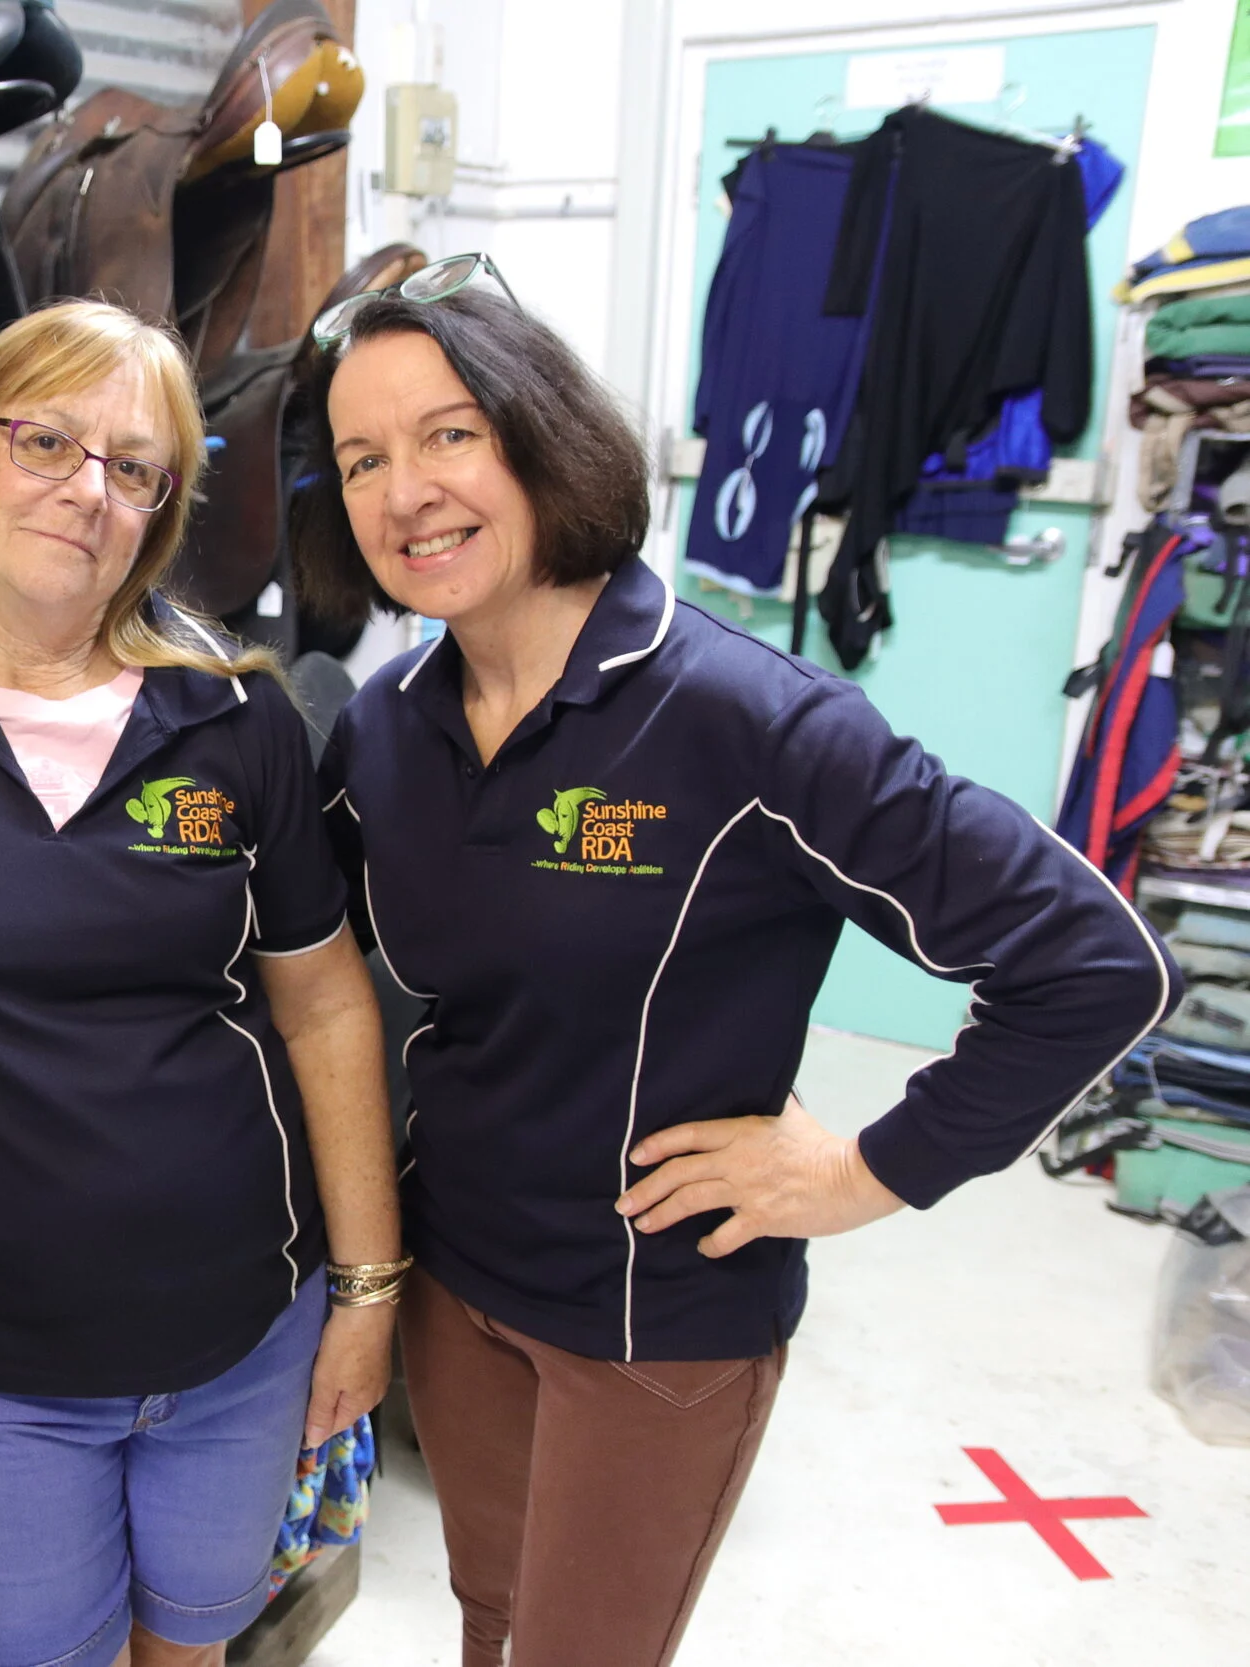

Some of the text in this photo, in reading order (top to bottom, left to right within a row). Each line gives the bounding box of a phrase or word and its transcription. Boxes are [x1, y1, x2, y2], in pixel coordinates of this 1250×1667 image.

[176, 804, 222, 822] Coast
[582, 799, 667, 820] Sunshine
[178, 820, 223, 845] RDA
[582, 819, 635, 837] Coast
[163, 844, 188, 855] Riding
[581, 836, 633, 861] RDA
[560, 861, 585, 874] Riding
[586, 863, 627, 875] Develops
